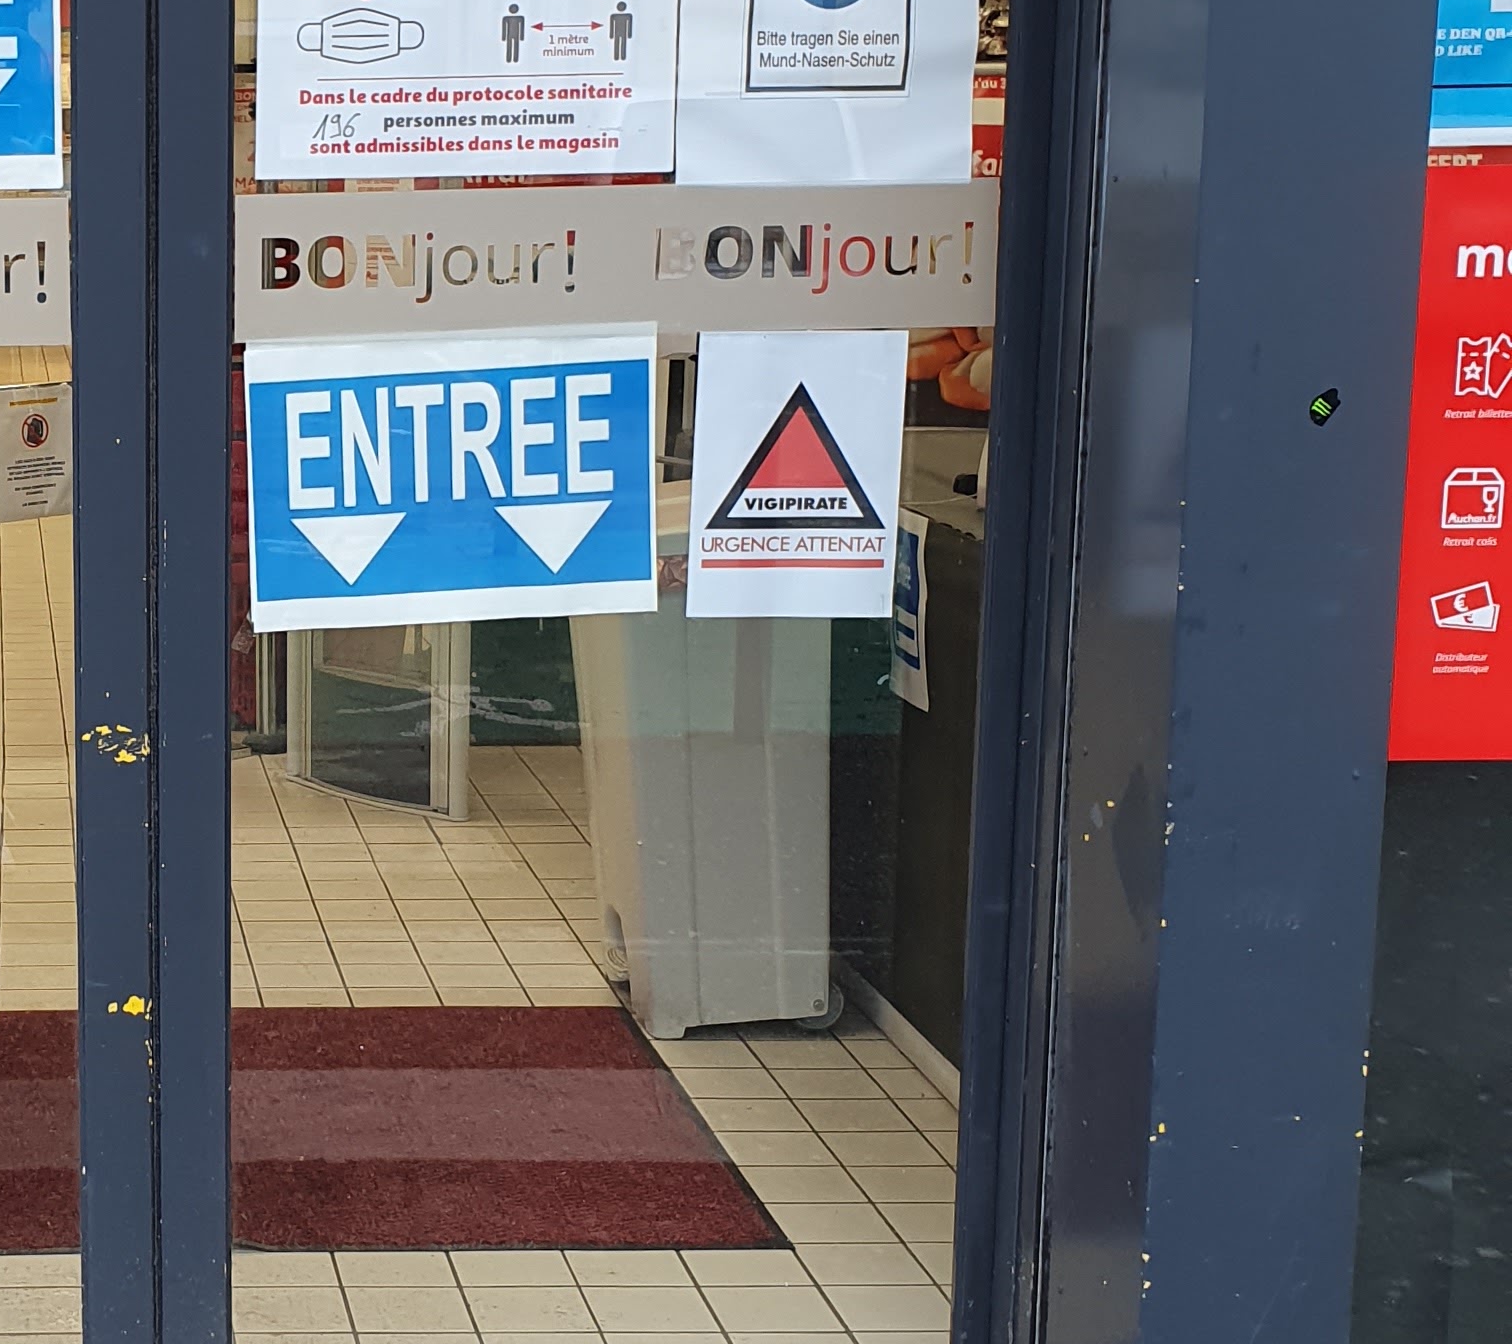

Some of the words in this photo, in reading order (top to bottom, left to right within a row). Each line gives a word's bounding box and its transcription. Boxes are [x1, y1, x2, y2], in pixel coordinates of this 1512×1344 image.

[549, 35, 555, 45] 1
[557, 33, 589, 45] mètre
[757, 30, 786, 46] Bitte
[791, 31, 833, 49] tragen
[838, 29, 859, 45] Sie
[863, 30, 899, 45] einen
[1449, 28, 1481, 40] DEN
[543, 45, 595, 57] minimum
[1447, 44, 1483, 57] LIKE
[759, 51, 895, 68] Mund-Nasen-Schutz
[299, 90, 345, 105] Dans
[349, 89, 366, 104] le
[371, 88, 422, 104] cadre
[426, 87, 449, 103] du
[452, 85, 543, 106] protocole
[547, 83, 633, 100] sanitaire
[312, 113, 361, 141] 196
[384, 114, 476, 132] personnes
[481, 109, 575, 126] maximum
[310, 138, 350, 155] sont
[355, 136, 464, 154] admissibles
[468, 135, 512, 151] dans
[517, 134, 534, 150] le
[538, 132, 619, 152] magasin
[261, 230, 577, 304] BONjour!
[285, 372, 615, 511] ENTREE
[744, 497, 848, 510] VIGIPIRATE
[1447, 512, 1497, 524] Auchan.fr
[701, 536, 790, 552] URGENCE
[794, 536, 886, 552] ATTENTAT
